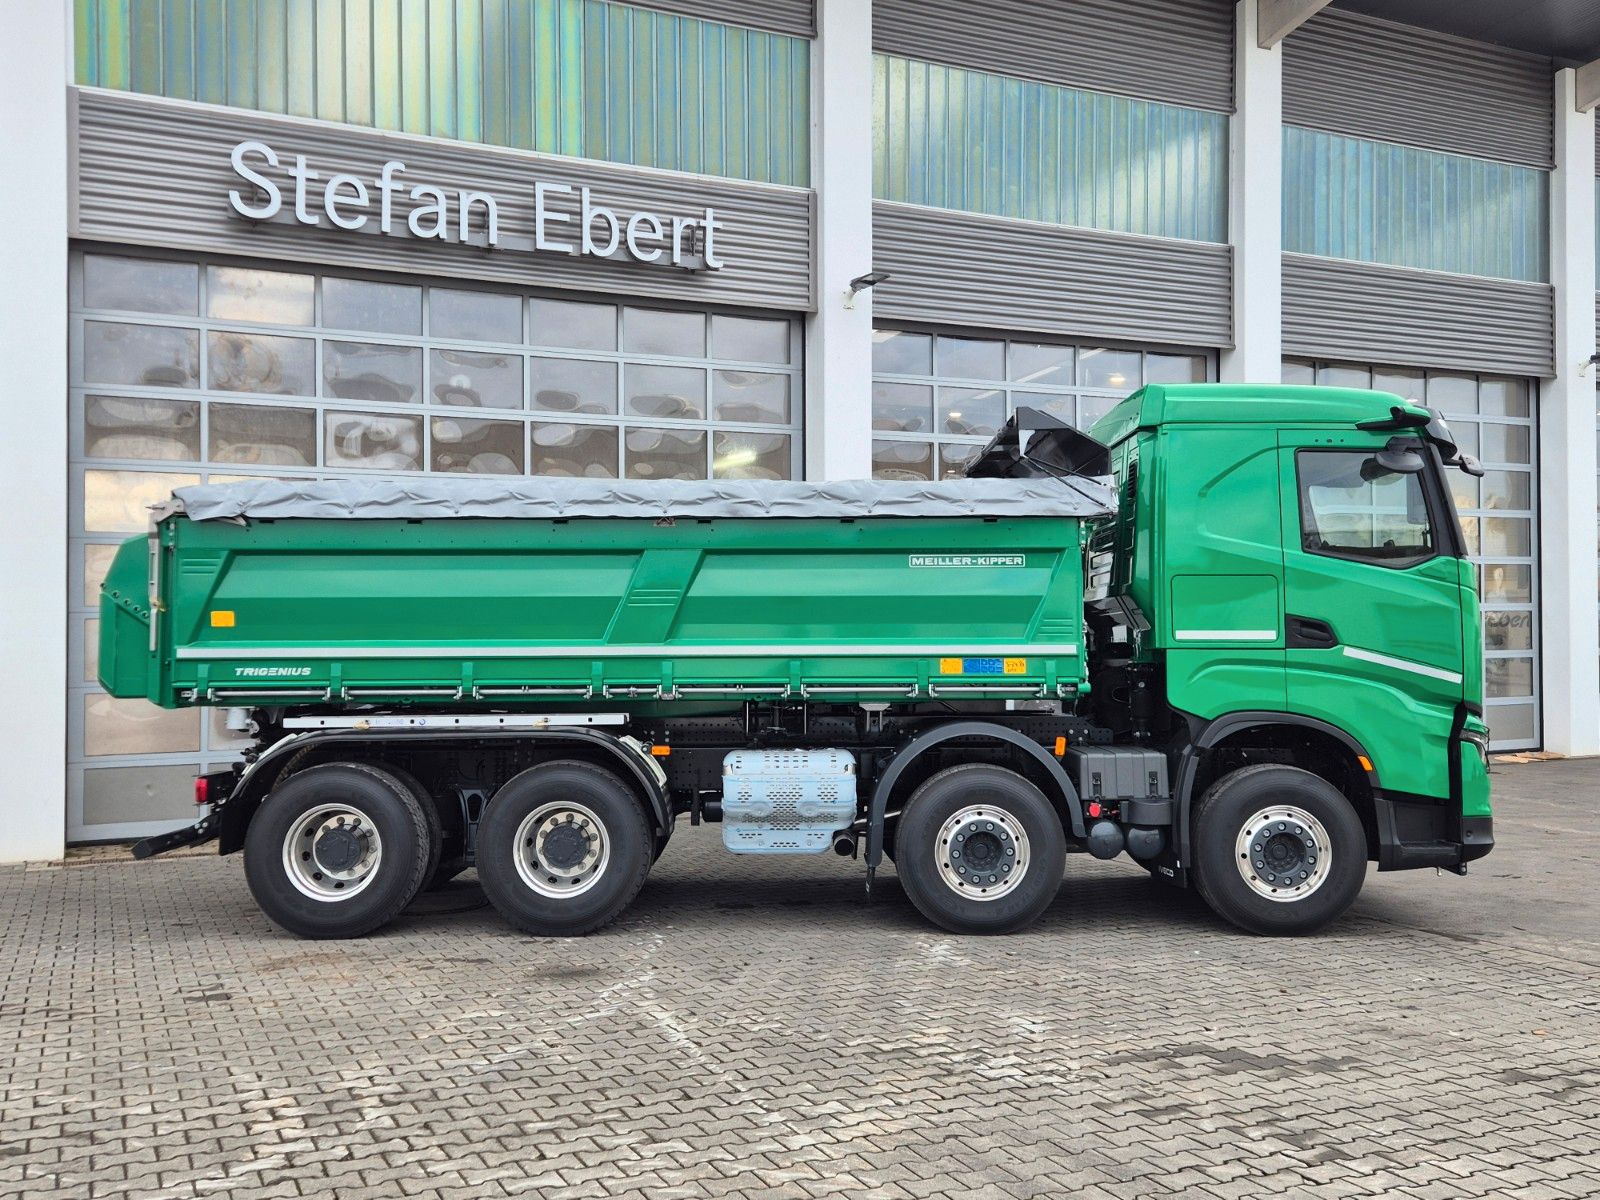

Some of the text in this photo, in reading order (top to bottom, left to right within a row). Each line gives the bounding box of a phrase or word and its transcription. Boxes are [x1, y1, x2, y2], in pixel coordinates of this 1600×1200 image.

[229, 141, 723, 270] Stefan Ebert
[911, 556, 1023, 566] MEILLER-KIPPER
[234, 667, 312, 677] TRIGENIUS
